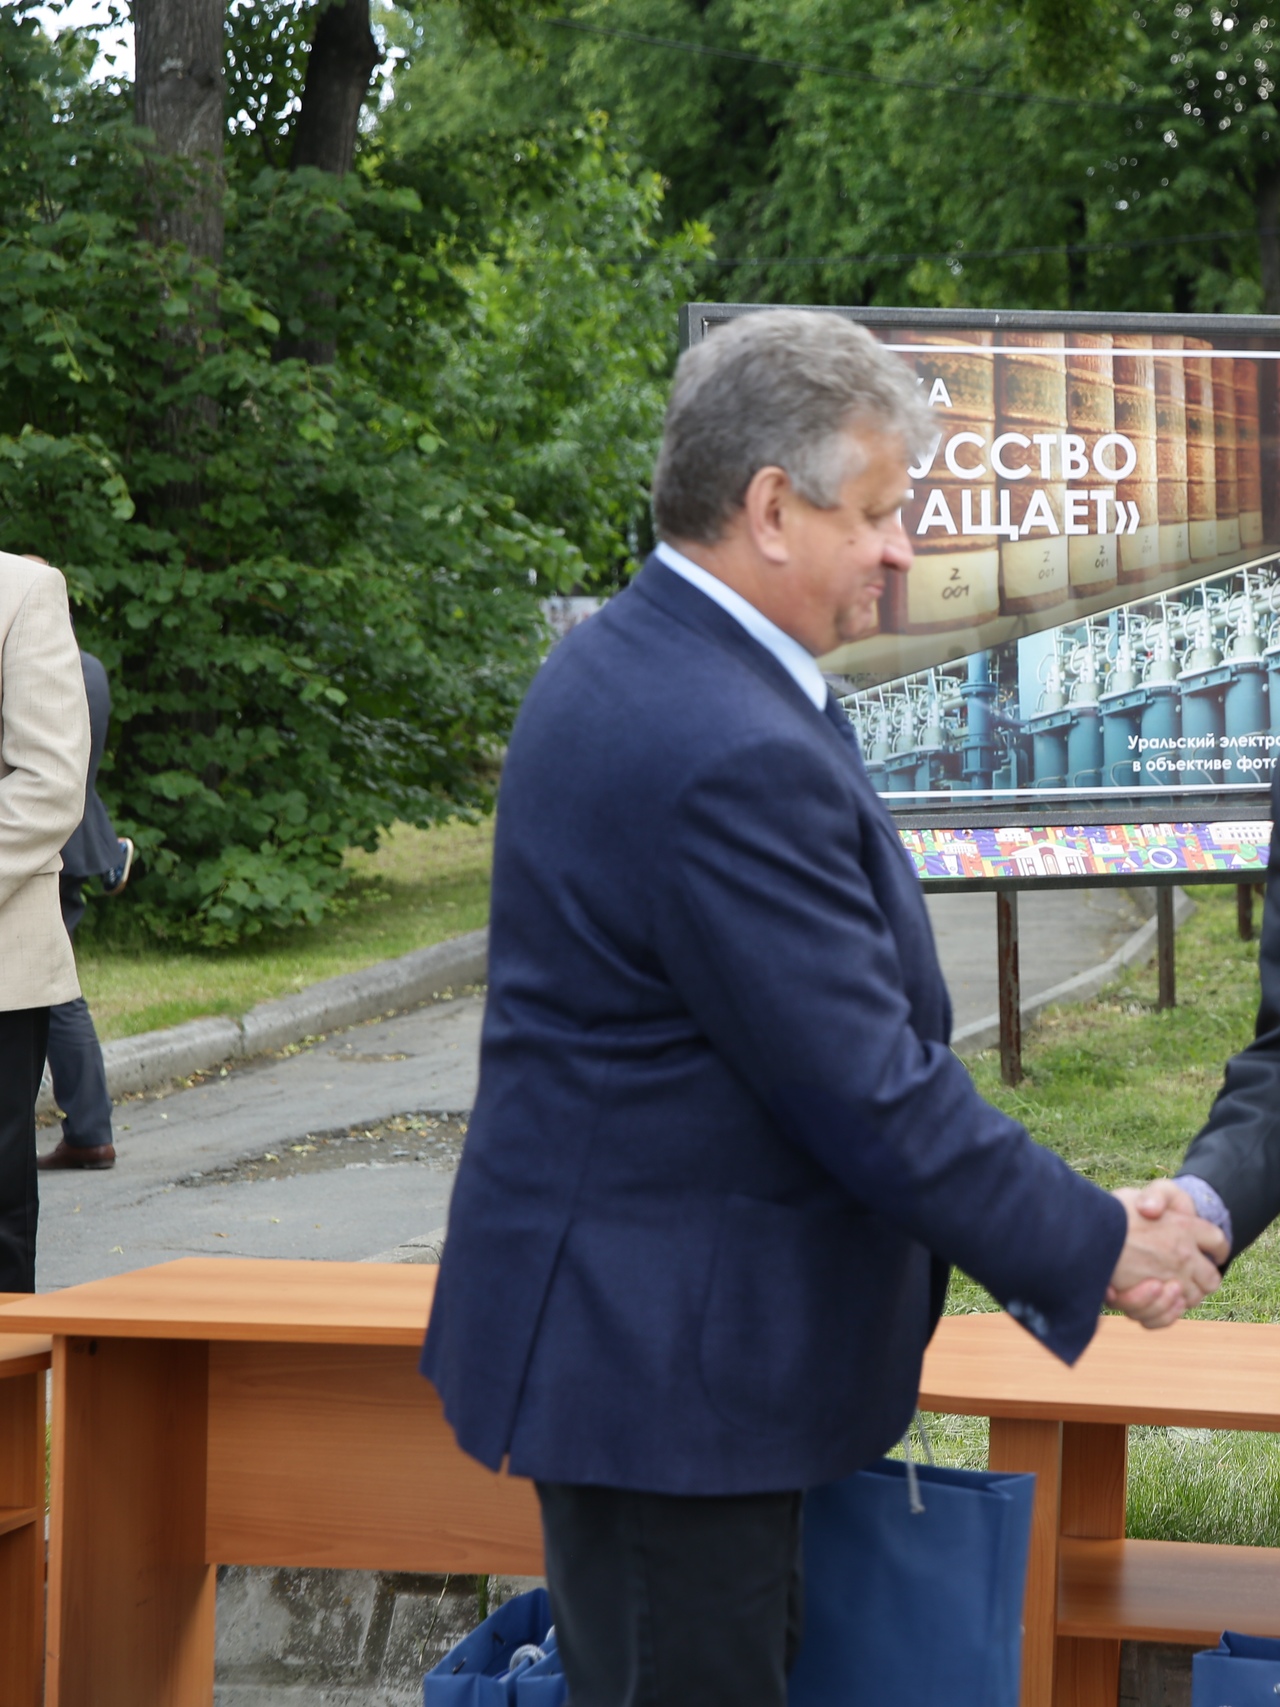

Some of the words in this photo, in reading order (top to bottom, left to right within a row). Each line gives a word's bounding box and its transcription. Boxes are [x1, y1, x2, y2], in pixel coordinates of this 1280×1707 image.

[1127, 732, 1215, 753] Уральский
[1132, 761, 1142, 773] в
[1145, 756, 1232, 773] объективе
